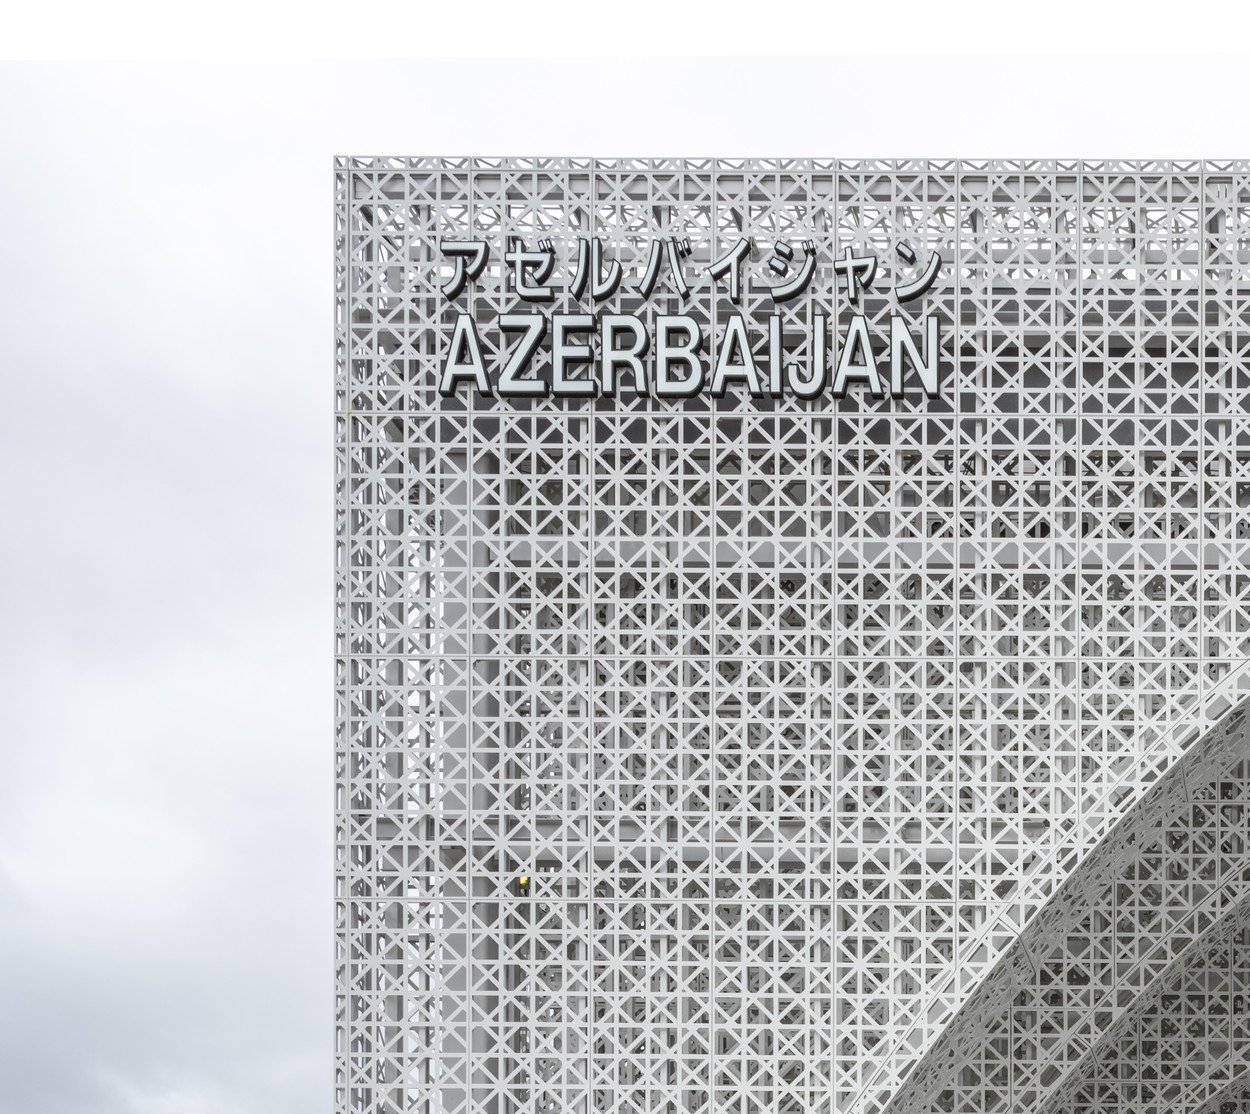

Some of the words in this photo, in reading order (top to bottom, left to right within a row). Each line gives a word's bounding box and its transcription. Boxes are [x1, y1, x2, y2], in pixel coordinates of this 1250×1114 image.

[439, 237, 940, 303] アゼルバイジャン
[438, 313, 940, 400] AZERBAIJAN
